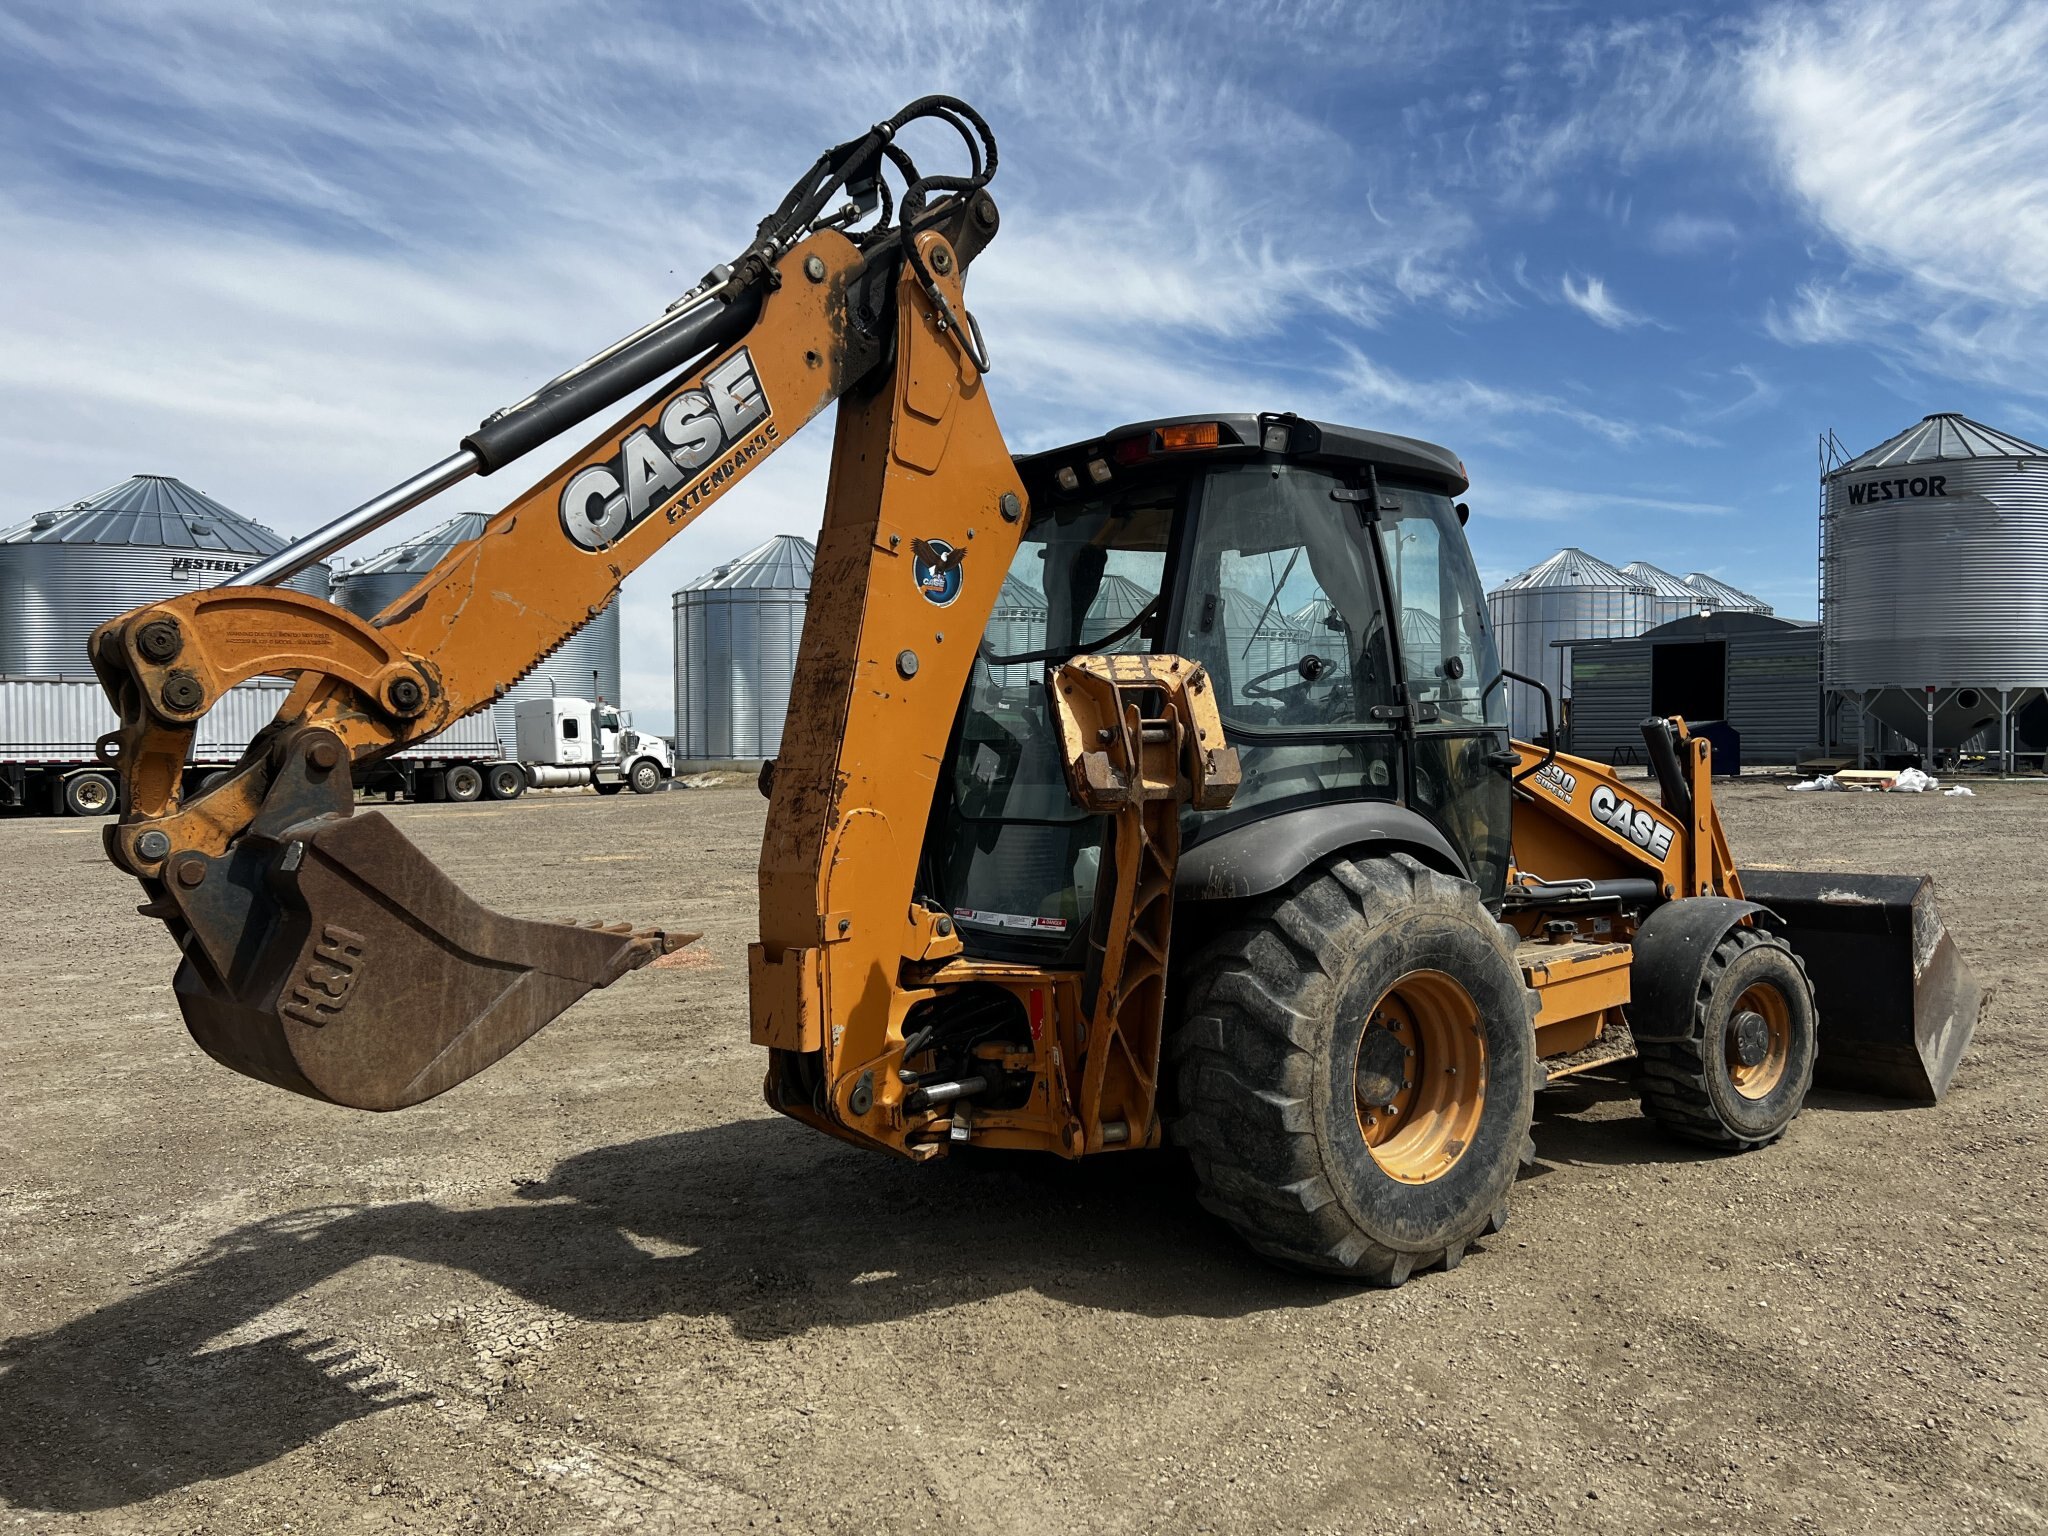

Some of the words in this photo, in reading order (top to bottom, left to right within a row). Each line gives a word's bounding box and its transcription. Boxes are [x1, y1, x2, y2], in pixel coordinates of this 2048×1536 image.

[561, 348, 769, 550] CASE
[1847, 475, 1948, 505] WESTOR
[1534, 773, 1565, 800] SUPER
[1590, 785, 1675, 861] CASE
